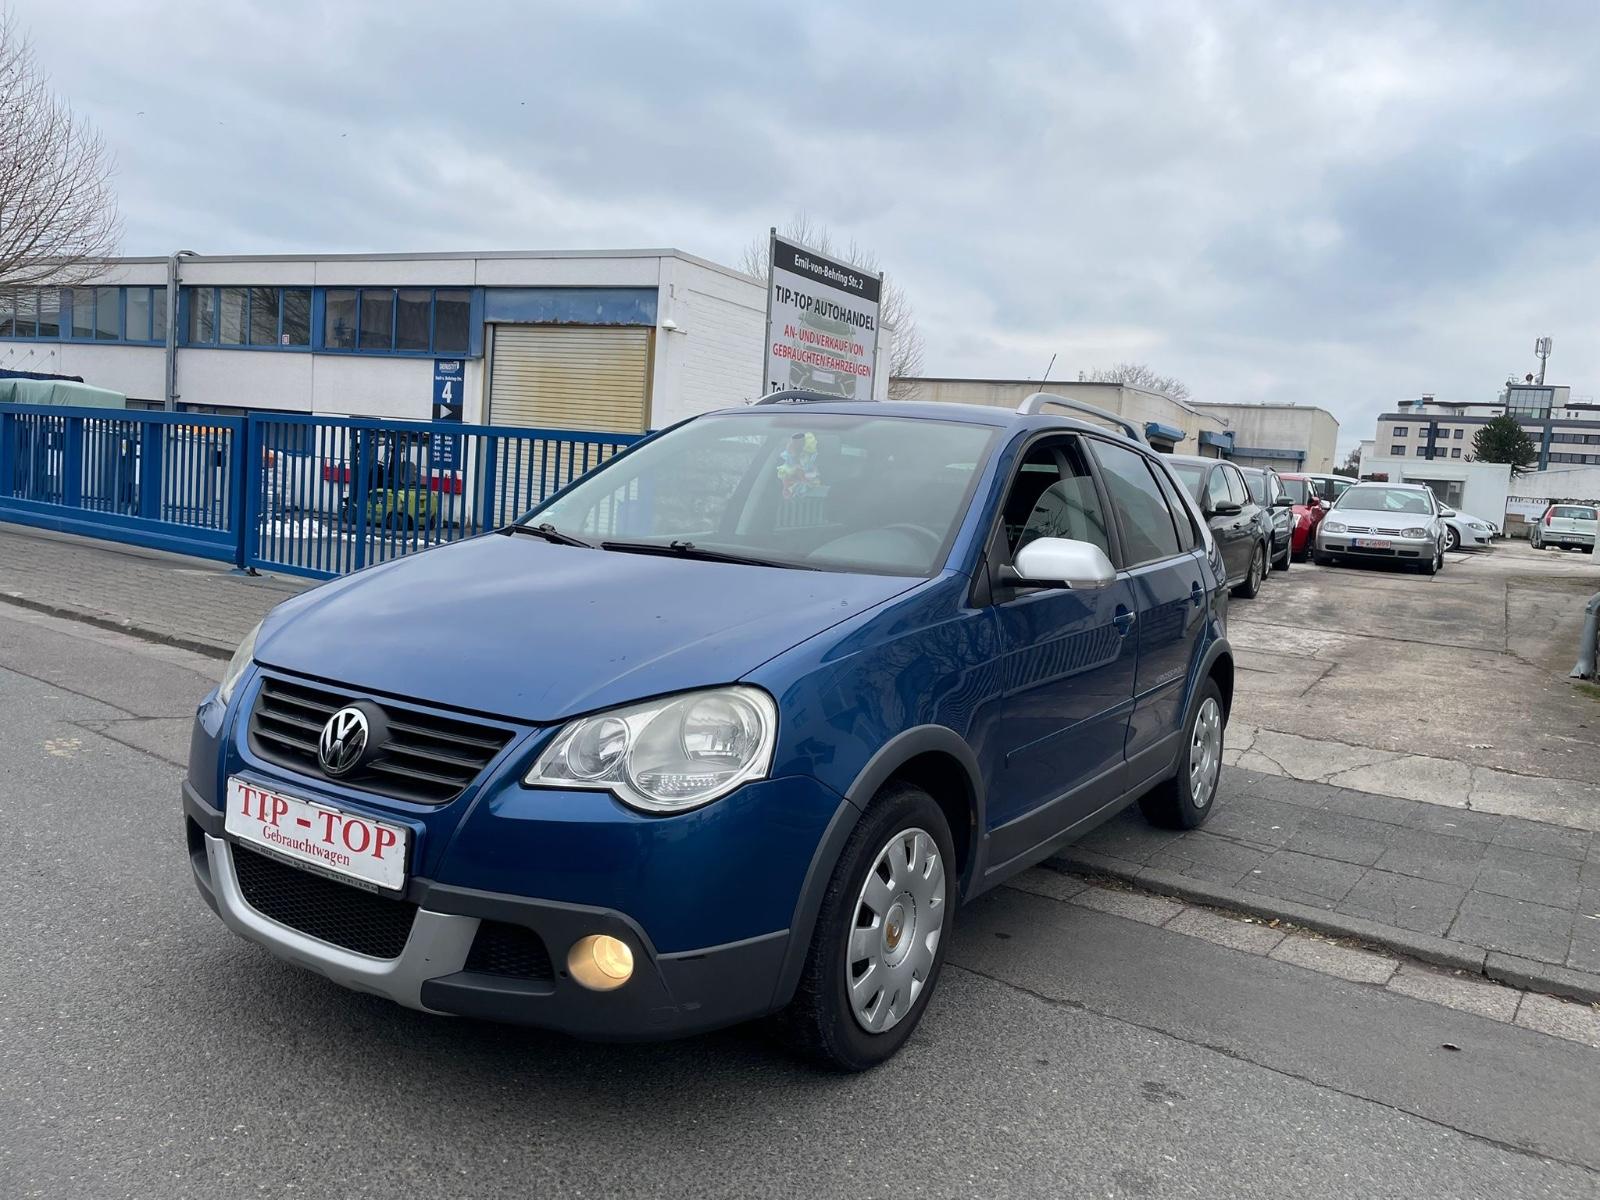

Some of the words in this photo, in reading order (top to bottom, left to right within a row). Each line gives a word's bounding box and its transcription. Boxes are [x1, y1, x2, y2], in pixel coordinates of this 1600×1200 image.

[794, 254, 848, 288] Emil-von-Behring
[848, 274, 859, 288] Str.
[858, 279, 864, 290] 2
[775, 285, 813, 311] TIP-TOP
[814, 299, 875, 331] AUTOHANDEL
[784, 324, 798, 338] AN-
[799, 330, 816, 343] UND
[816, 333, 849, 353] VERKAUF
[849, 345, 864, 357] VON
[773, 343, 826, 366] GEBRAUCHTEN
[826, 356, 871, 377] FAHRZEUGEN
[441, 381, 452, 403] 4
[238, 784, 289, 828] TIP
[318, 811, 397, 860] TOP
[262, 826, 350, 867] Gebrauchtwagen
